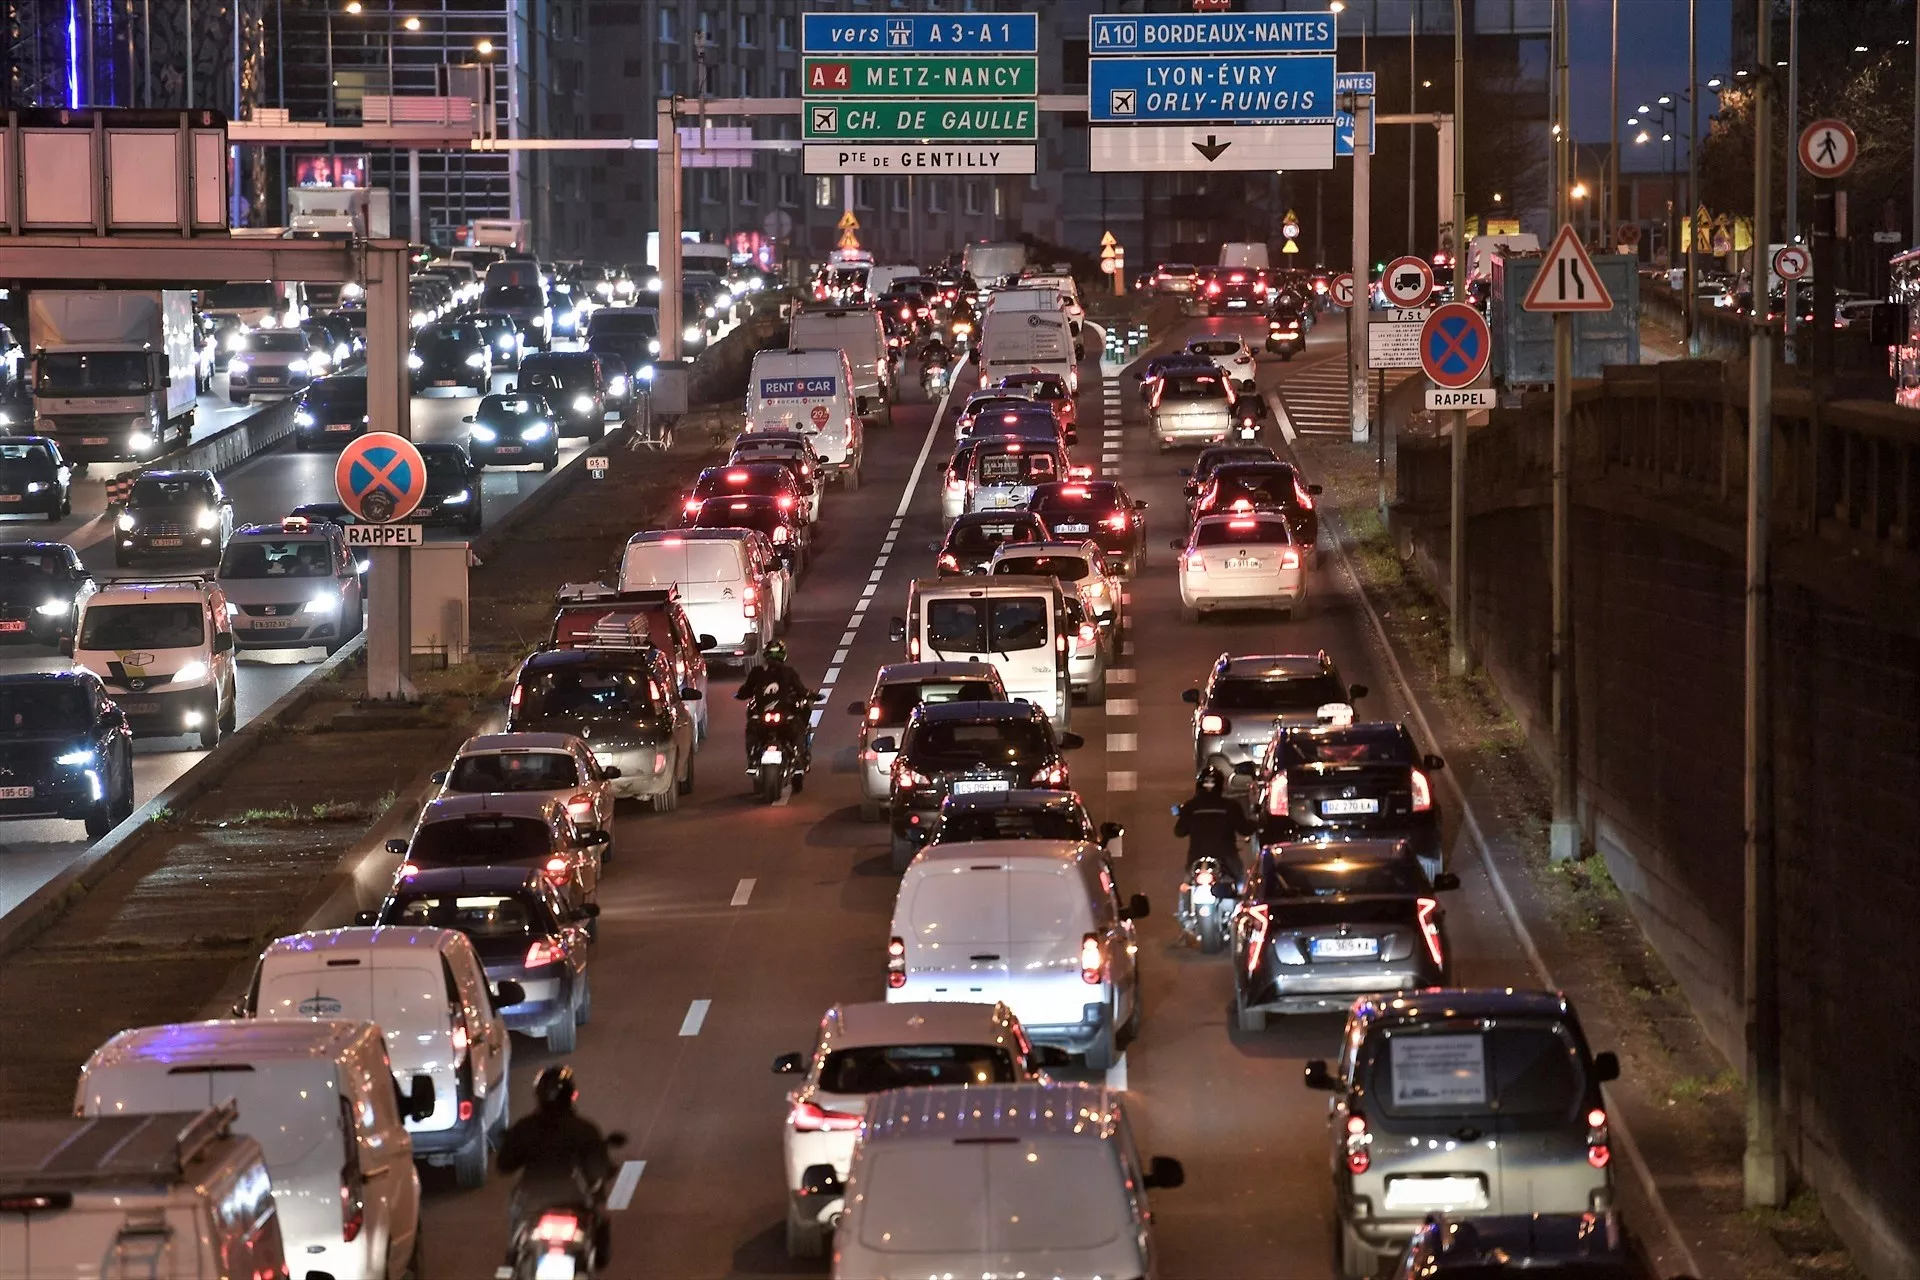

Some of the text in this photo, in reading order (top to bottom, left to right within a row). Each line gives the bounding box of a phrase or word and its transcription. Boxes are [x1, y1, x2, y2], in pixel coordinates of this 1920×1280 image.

[832, 28, 879, 42] vers
[1144, 22, 1329, 44] BORDEAUX-NANTES
[867, 67, 1021, 86] METZ-NANCY
[1147, 63, 1277, 86] LYON-ÉVRY
[1147, 91, 1315, 112] ORLY-RUNGIS
[846, 110, 1029, 130] CH. DE GAULLE
[873, 157, 889, 167] DE
[901, 152, 1000, 167] GENTILLY
[1417, 311, 1422, 320] t
[765, 382, 794, 393] RENT
[807, 381, 831, 392] CAR
[1435, 393, 1486, 405] RAPPEL
[349, 528, 417, 543] RAPPEL
